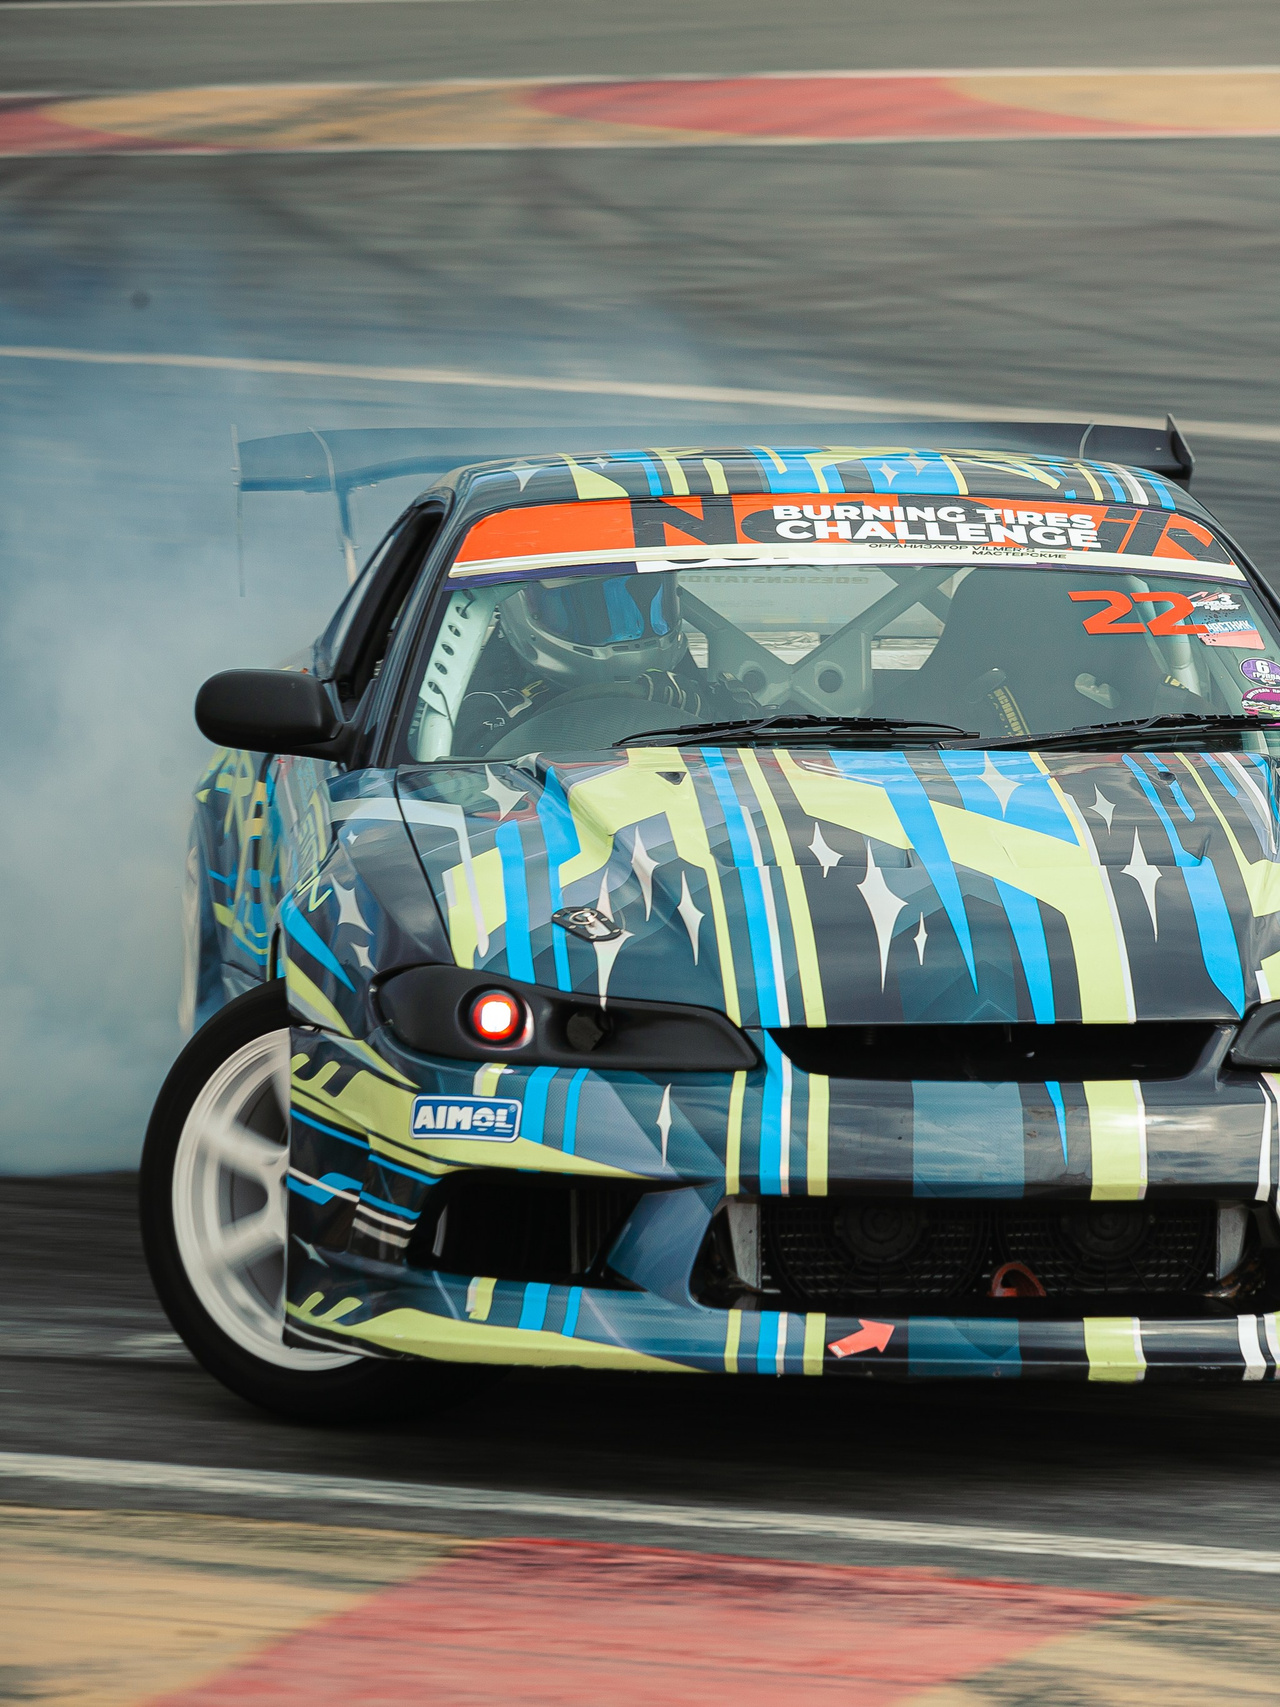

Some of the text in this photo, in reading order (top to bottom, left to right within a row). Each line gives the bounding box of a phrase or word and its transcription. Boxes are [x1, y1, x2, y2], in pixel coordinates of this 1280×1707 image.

[772, 504, 1097, 529] BURNING TIRES
[775, 520, 1102, 548] CHALLENGE
[971, 550, 1067, 560] МАСТЕРСКИЕ
[1067, 590, 1211, 636] 22
[1205, 620, 1253, 634] ЧАСТНИК
[1255, 660, 1270, 674] 6
[413, 1105, 514, 1133] AIMOL
